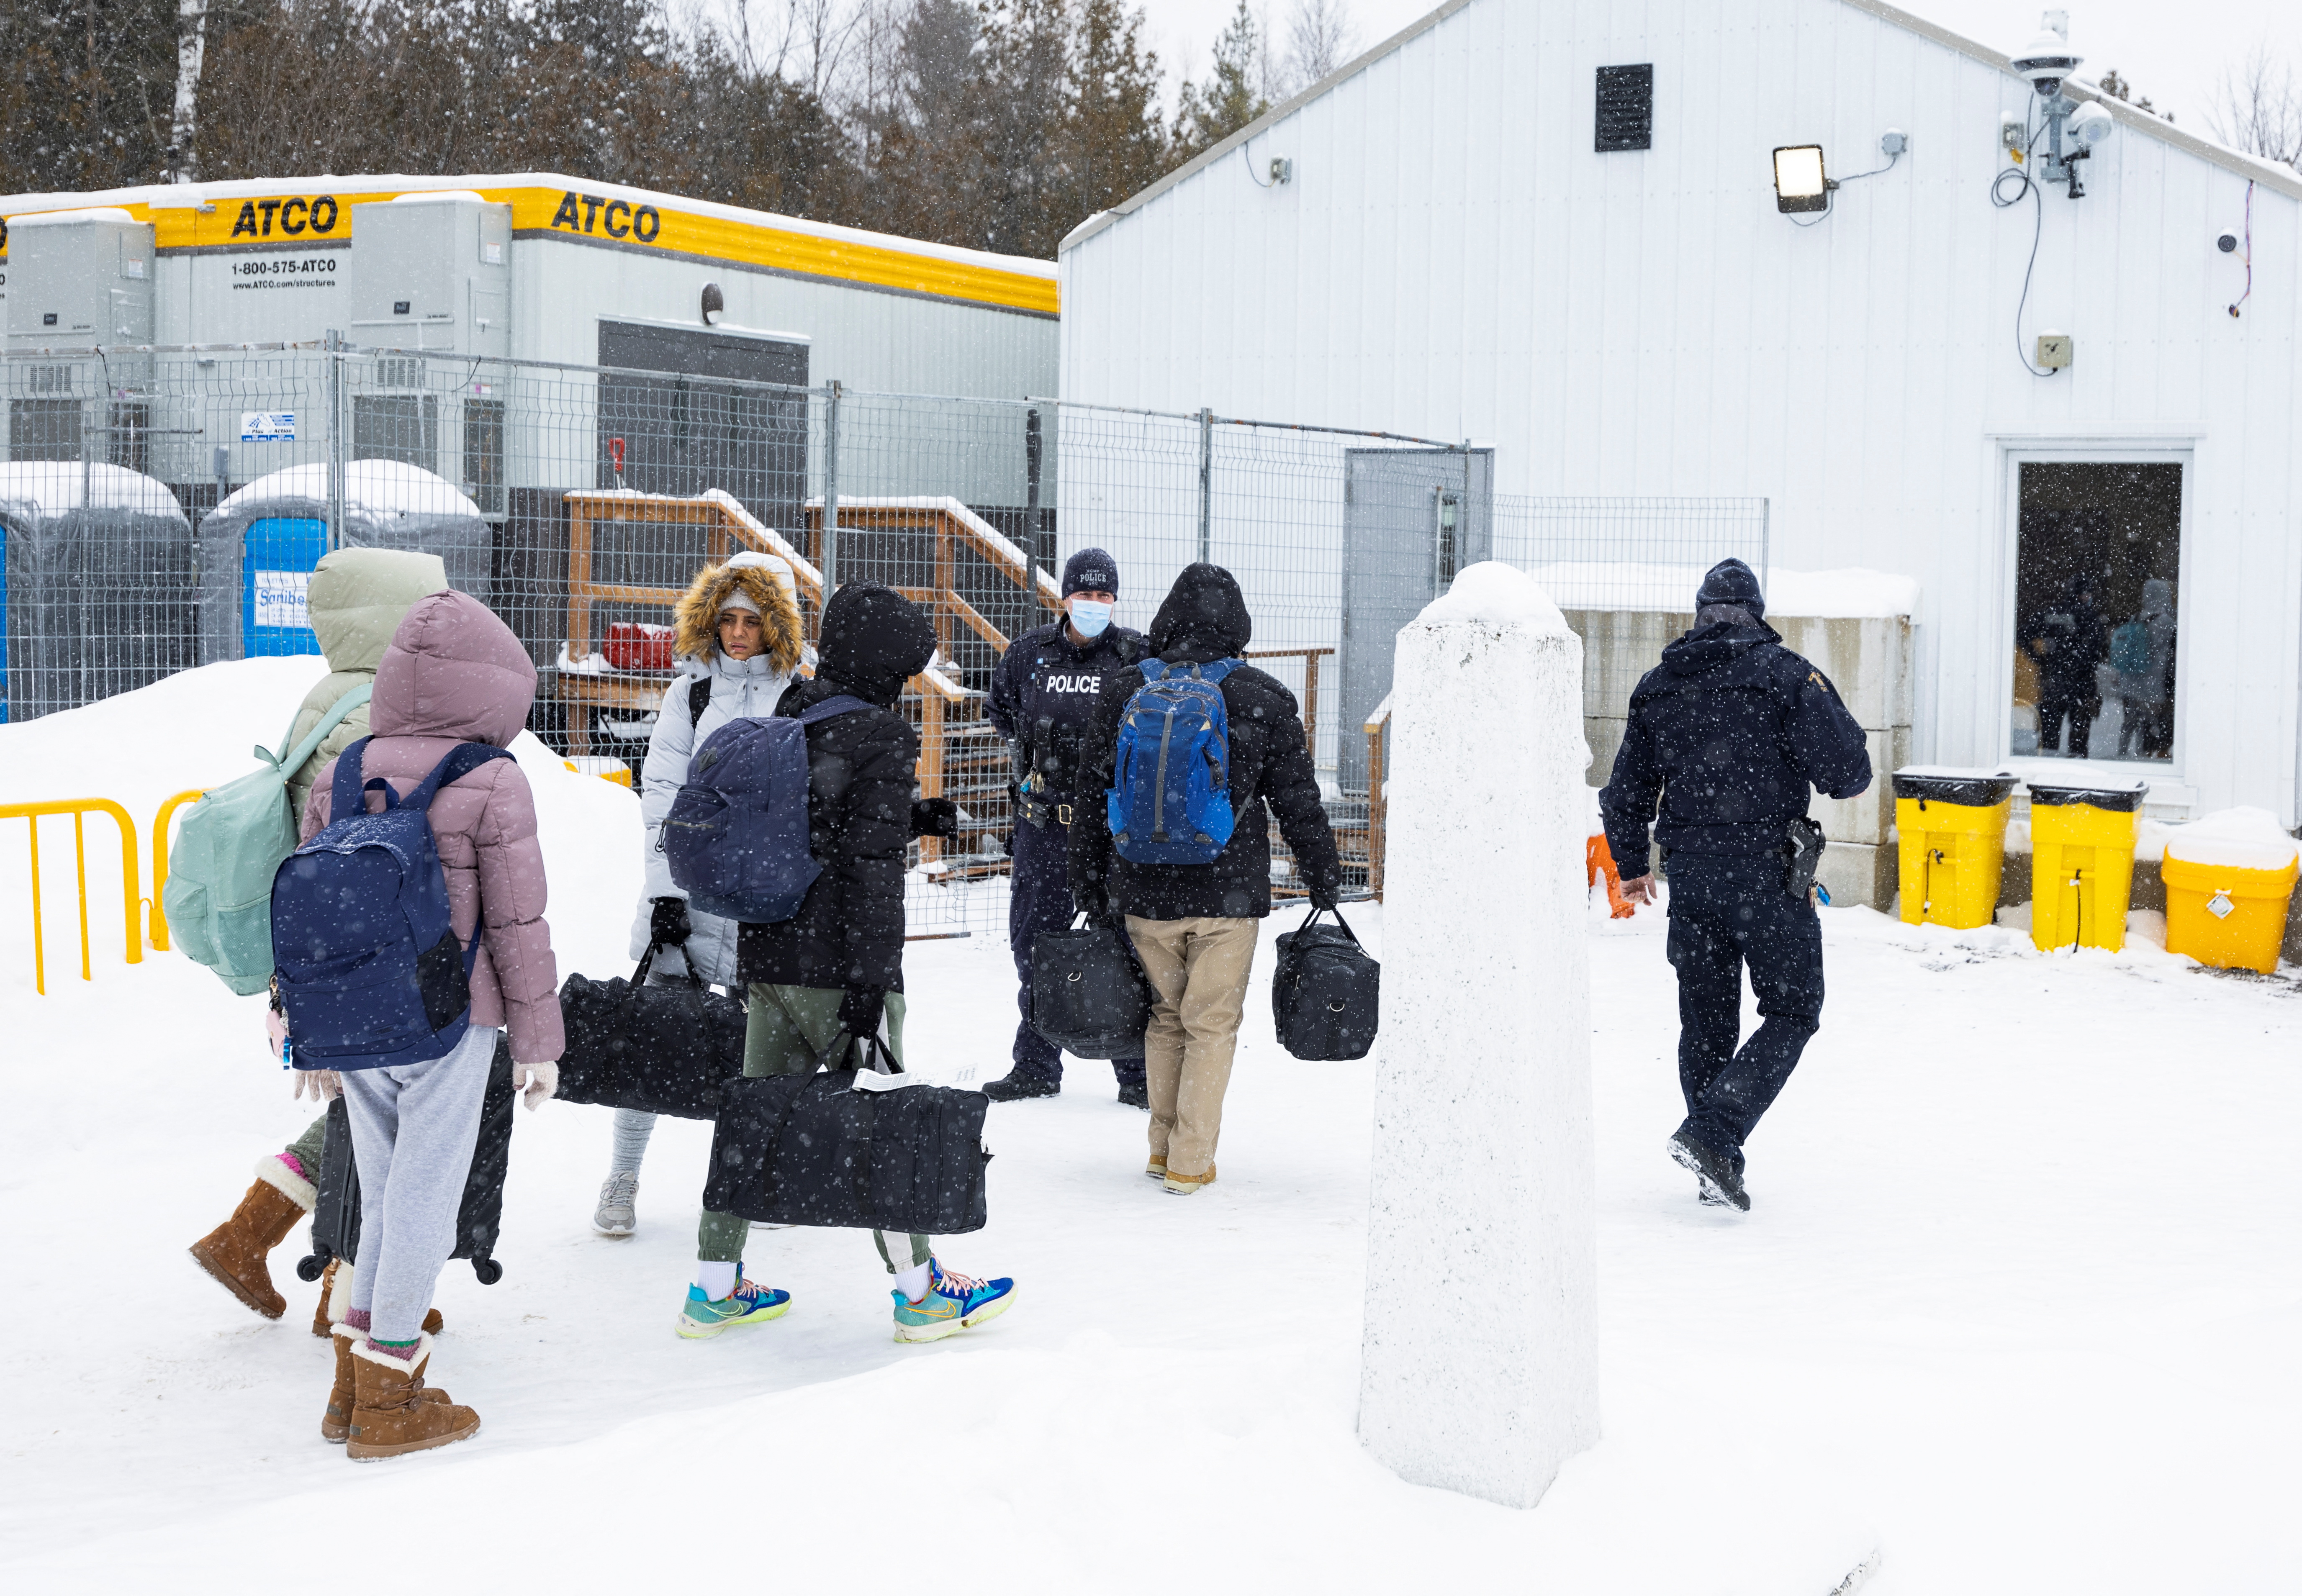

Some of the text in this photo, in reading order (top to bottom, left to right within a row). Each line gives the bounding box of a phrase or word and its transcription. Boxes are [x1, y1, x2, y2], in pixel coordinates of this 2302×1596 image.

[231, 196, 338, 237] ATCO
[551, 191, 660, 242] ATCO
[232, 259, 335, 274] 1-800-575-ATCO
[233, 279, 335, 289] www.ATCO.com/structures
[1080, 573, 1106, 582] POLICE
[260, 589, 307, 606] Sanibe
[1046, 675, 1101, 693] POLICE
